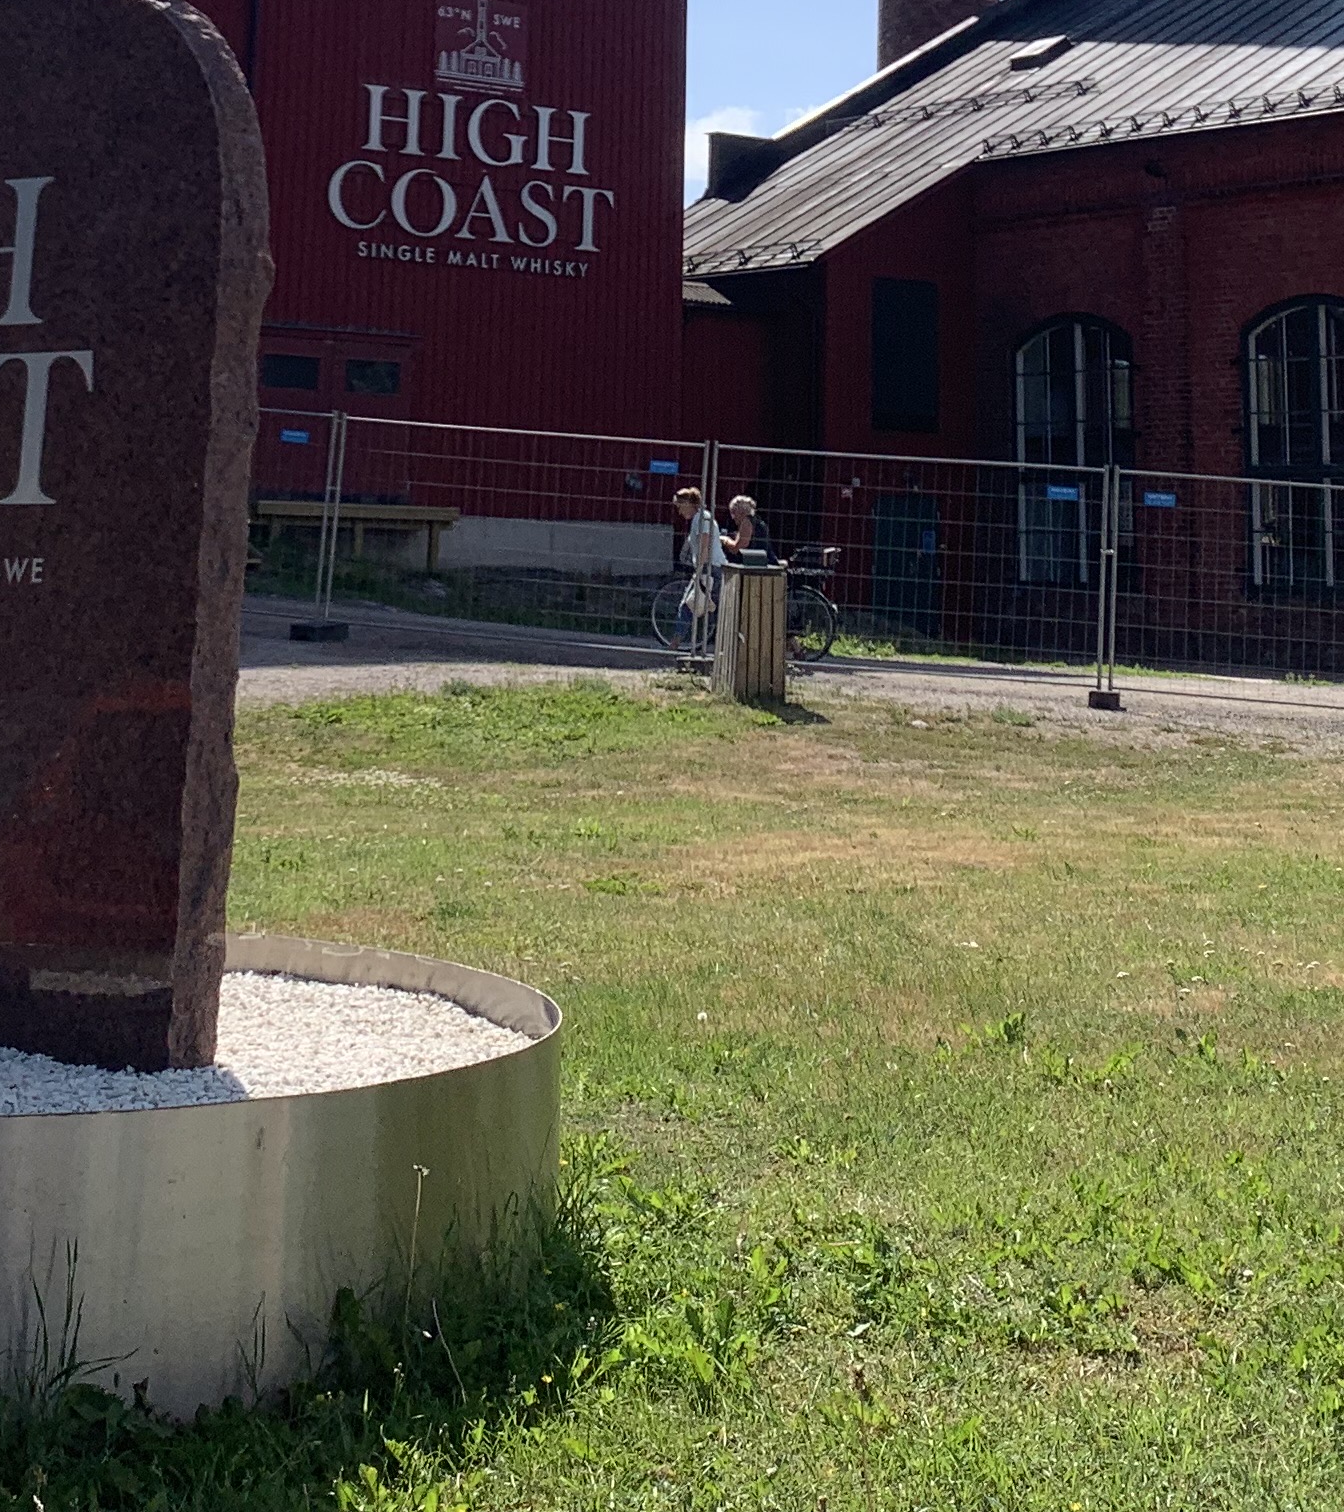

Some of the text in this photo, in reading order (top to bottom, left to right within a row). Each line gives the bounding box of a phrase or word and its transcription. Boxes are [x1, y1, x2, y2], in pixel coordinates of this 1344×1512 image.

[493, 14, 521, 29] SWE
[362, 84, 591, 175] HIGH
[328, 160, 615, 253] COAST
[357, 241, 589, 278] SINGLE MALT WHISKY
